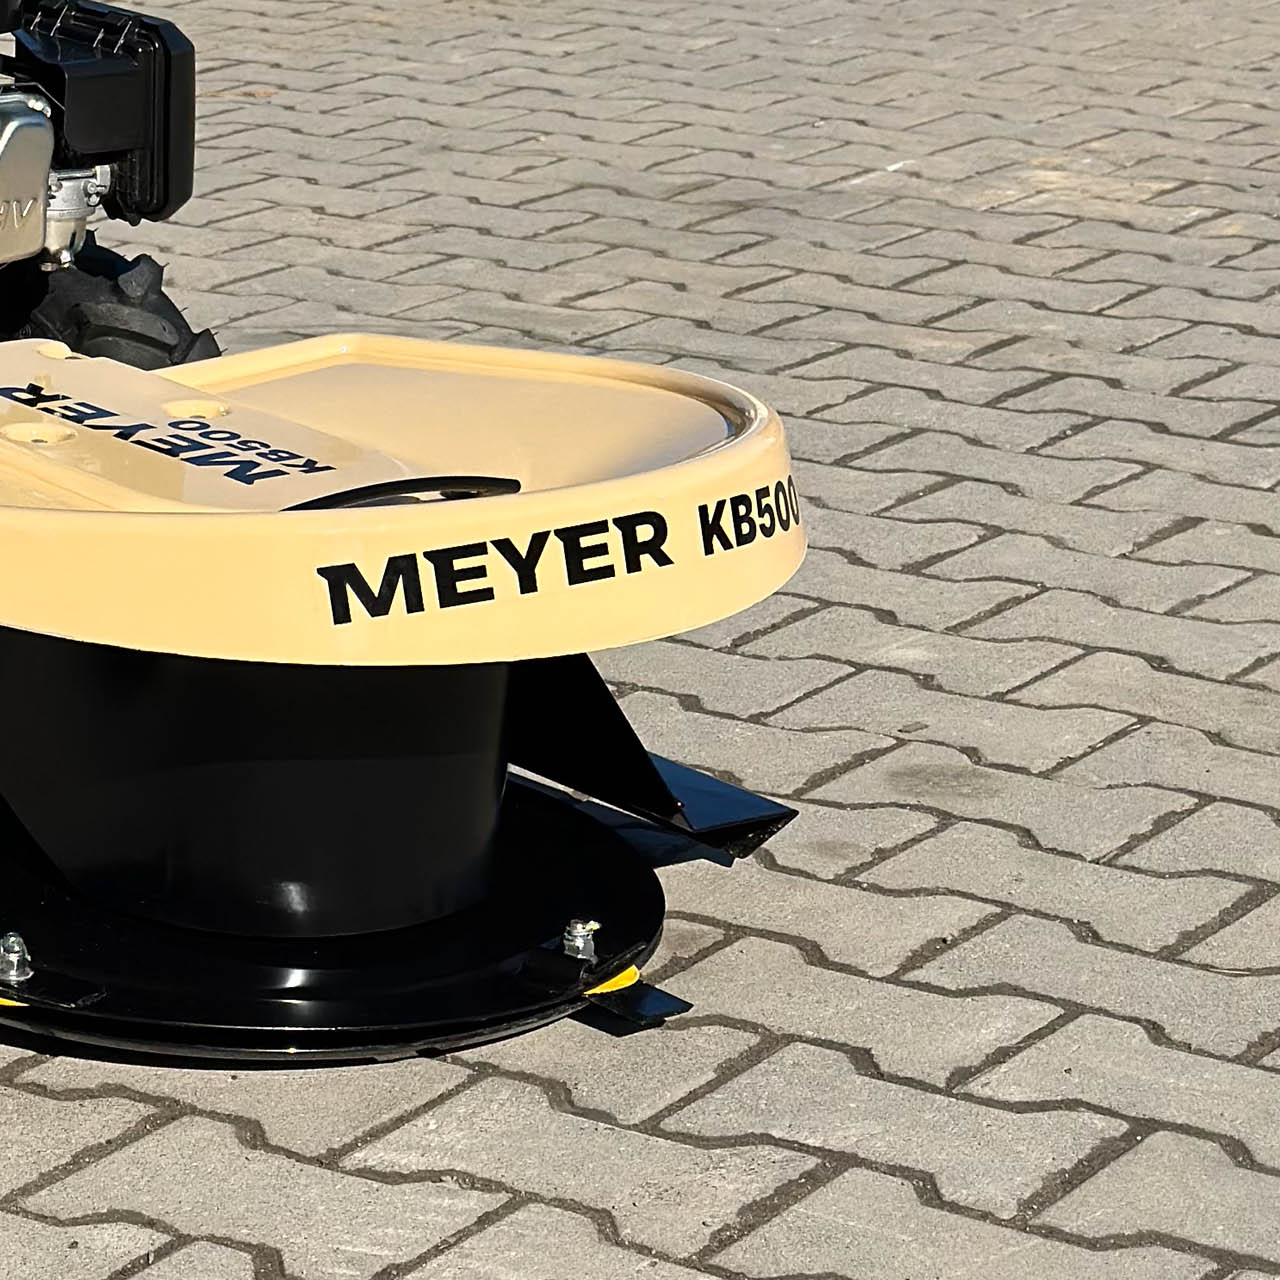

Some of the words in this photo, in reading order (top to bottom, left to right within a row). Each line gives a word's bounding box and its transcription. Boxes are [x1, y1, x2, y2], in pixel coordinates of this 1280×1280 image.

[167, 419, 337, 474] KB500
[316, 510, 675, 625] MEYER
[698, 474, 801, 557] KB500
